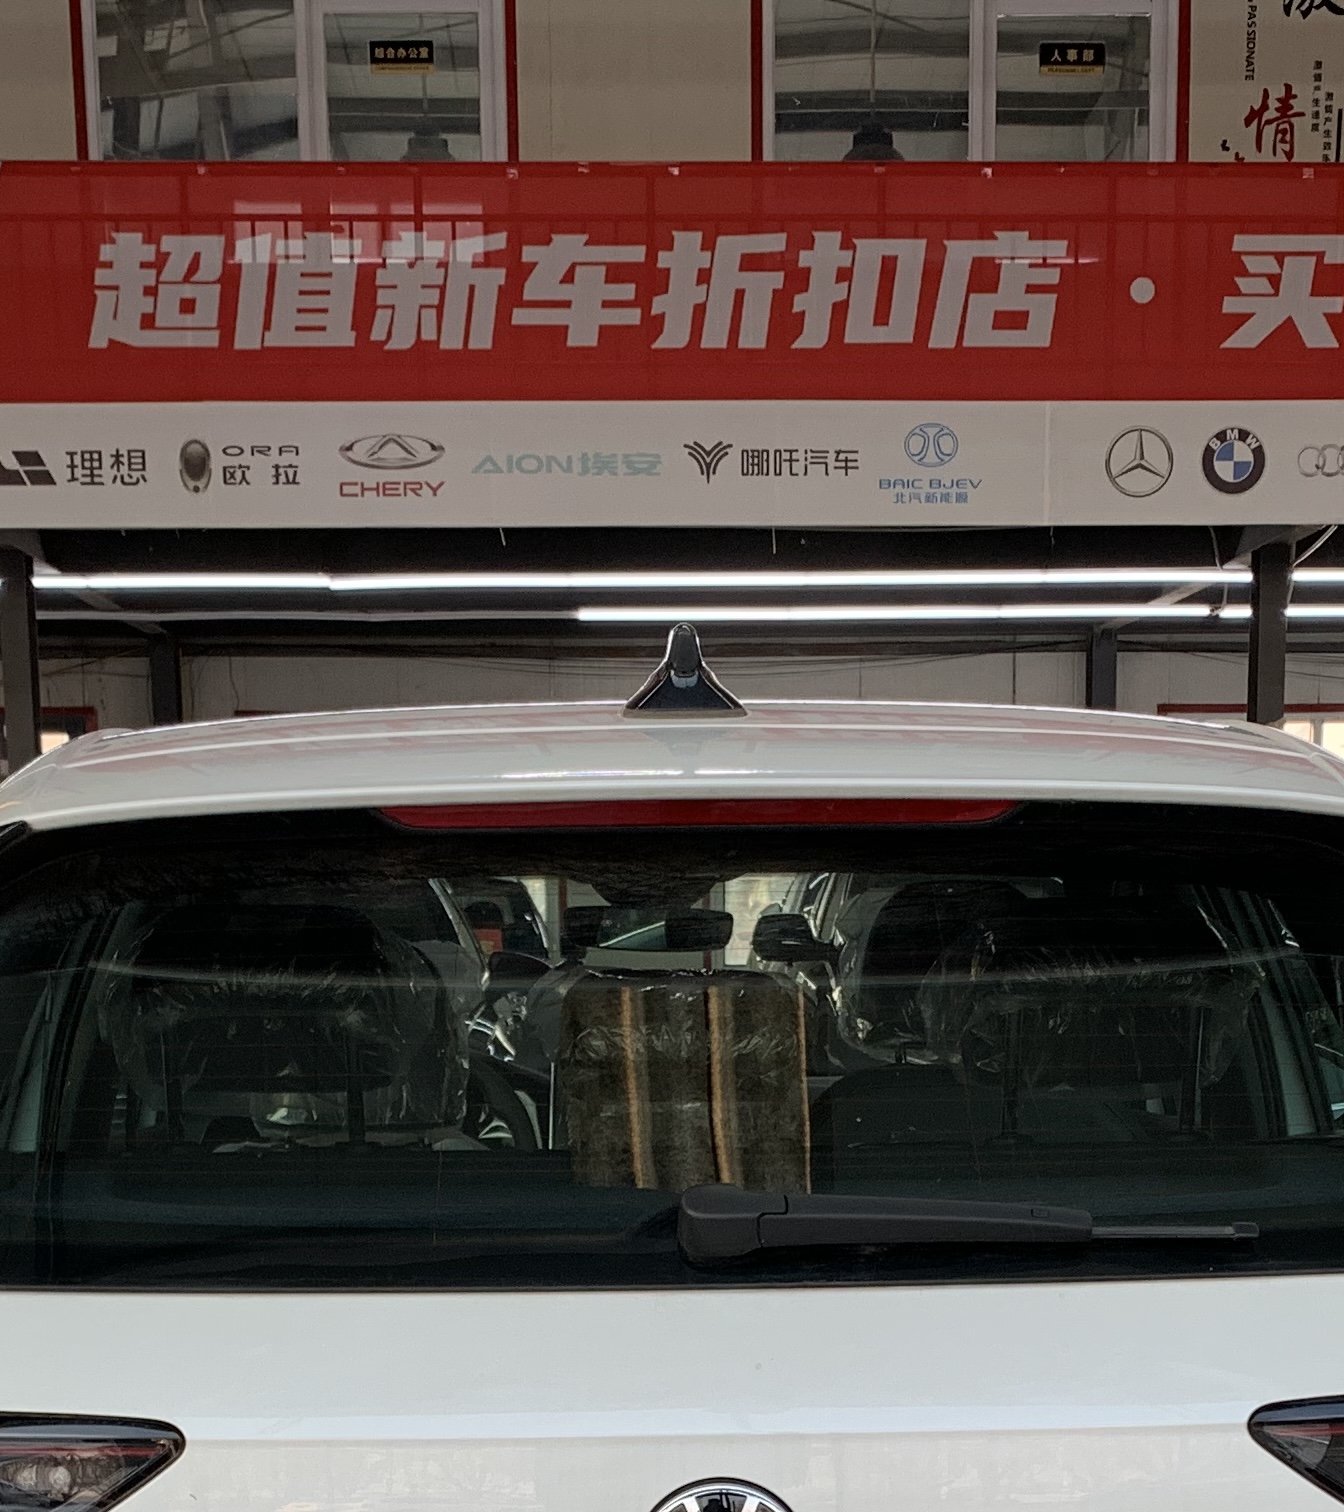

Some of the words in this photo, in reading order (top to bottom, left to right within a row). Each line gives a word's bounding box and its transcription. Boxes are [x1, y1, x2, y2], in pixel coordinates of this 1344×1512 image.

[1244, 5, 1257, 81] PASSIONATE
[1243, 82, 1306, 162] 情
[221, 444, 301, 457] ORA
[1208, 428, 1259, 450] BMW
[64, 448, 148, 487] 理想
[221, 462, 302, 487] 欧拉
[740, 448, 860, 478] 哪吒汽车
[338, 480, 446, 498] CHERY
[879, 478, 924, 490] BAIC
[929, 478, 983, 490] BJEV
[892, 491, 970, 504] 北汽新能源
